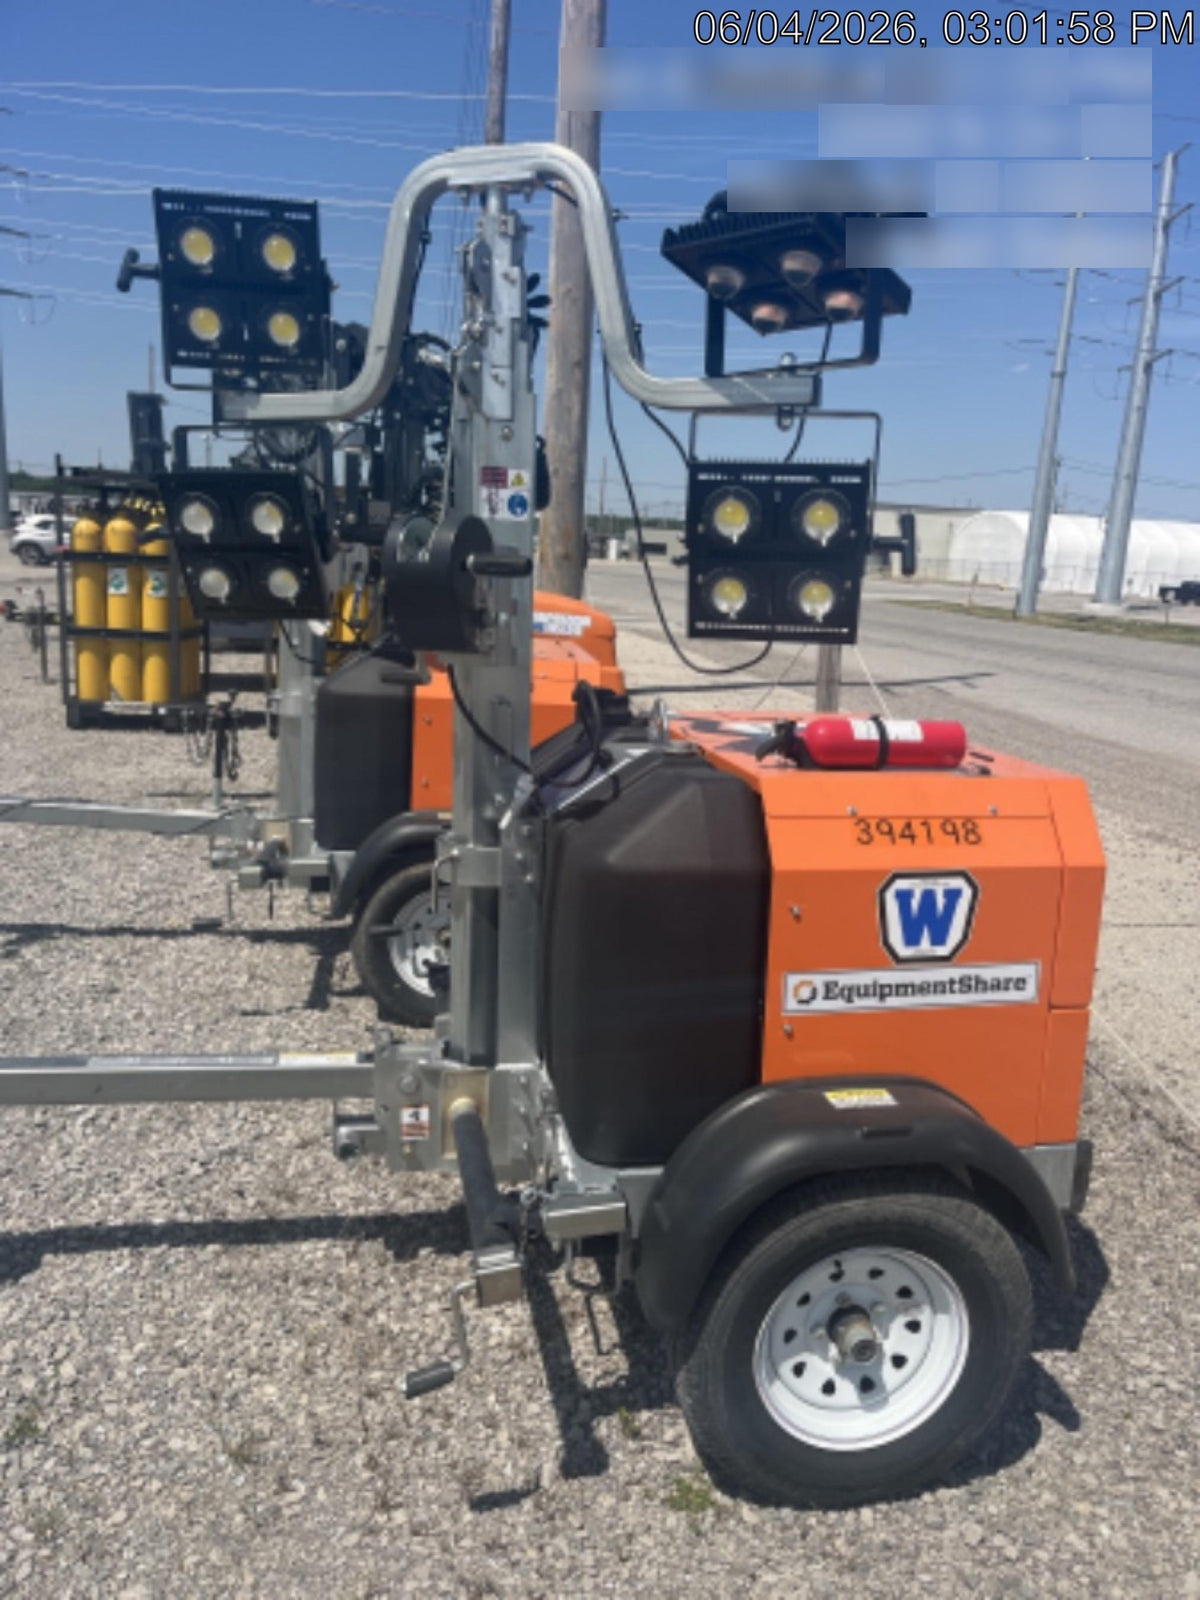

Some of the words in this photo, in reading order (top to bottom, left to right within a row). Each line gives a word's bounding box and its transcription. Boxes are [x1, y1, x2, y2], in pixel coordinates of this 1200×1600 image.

[854, 817, 982, 846] 394198
[894, 887, 963, 947] W
[822, 973, 1028, 1004] EquipmentShare
